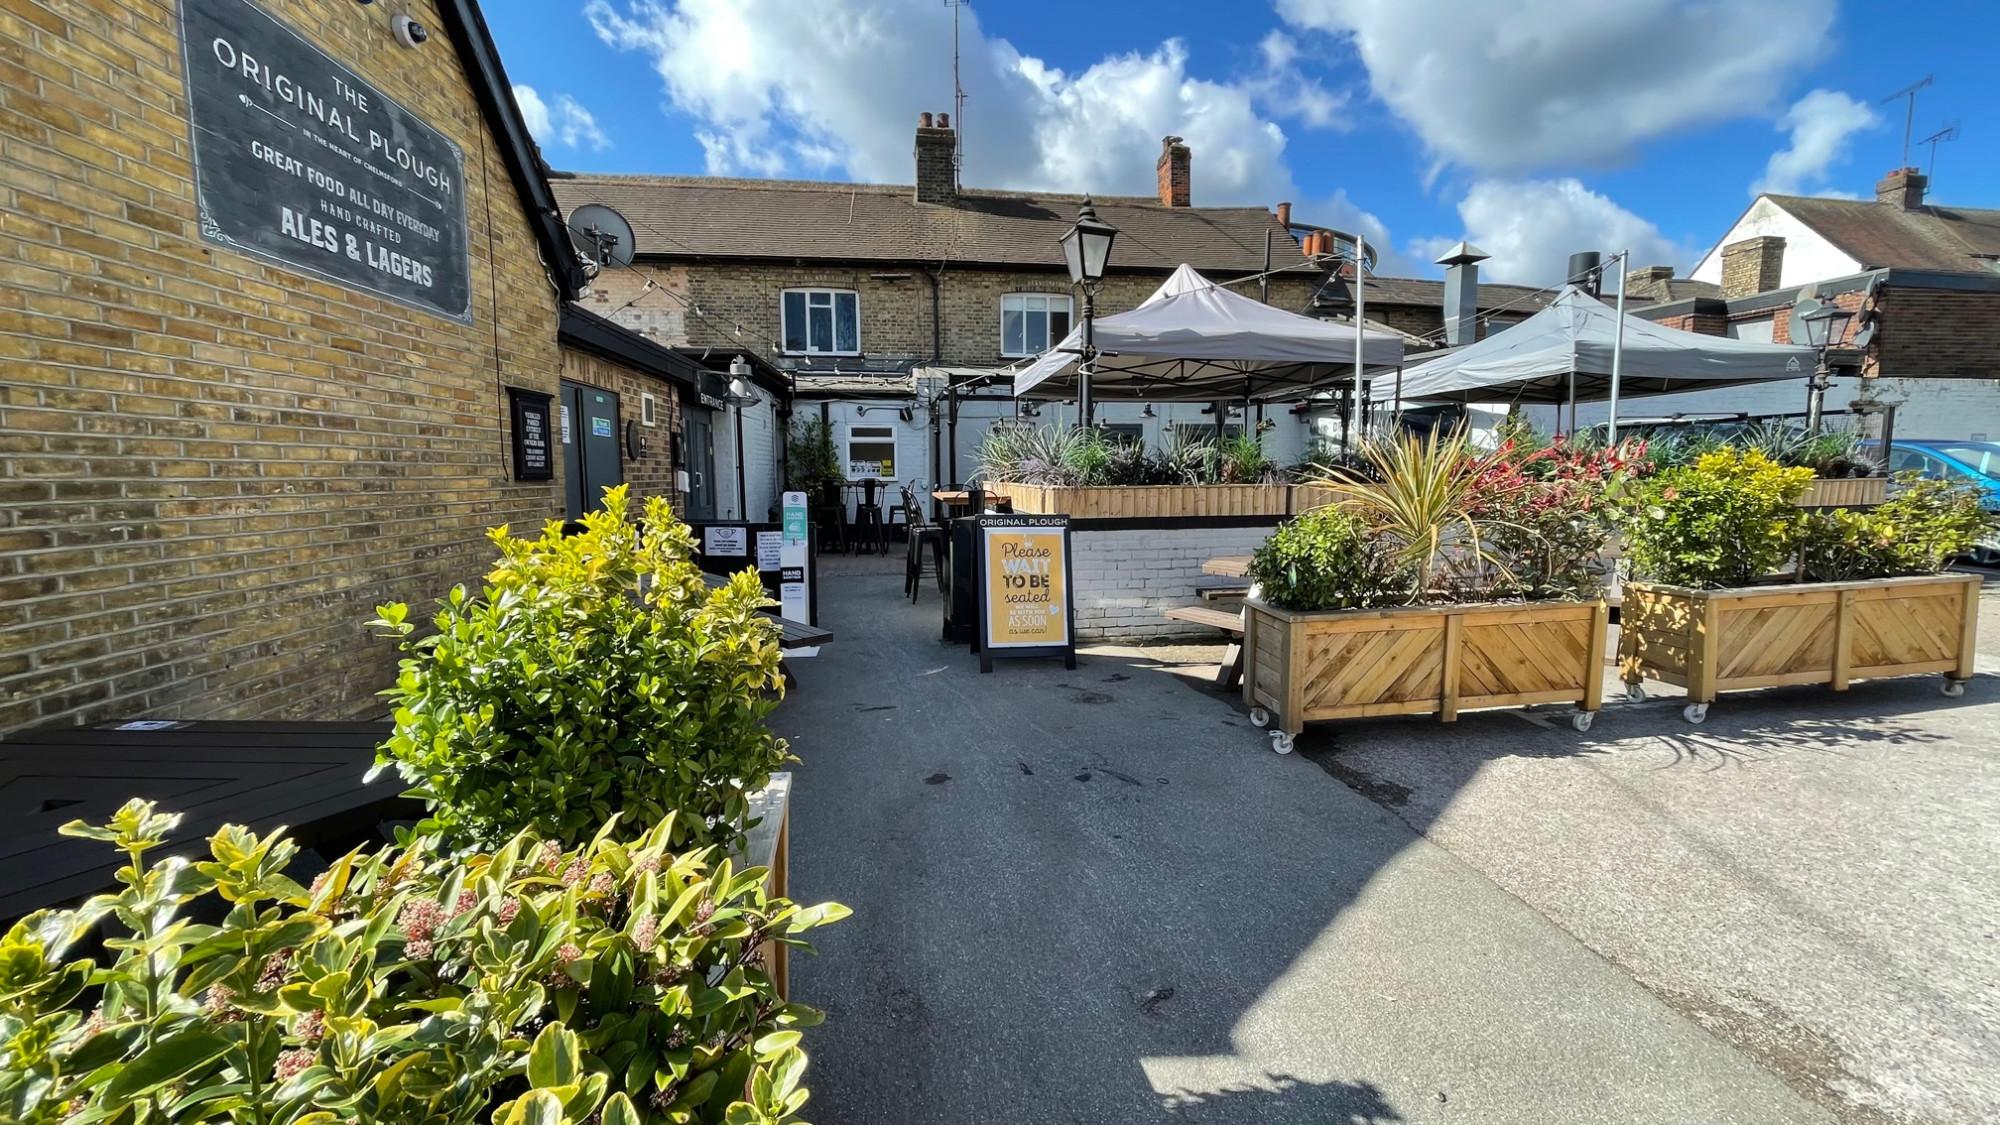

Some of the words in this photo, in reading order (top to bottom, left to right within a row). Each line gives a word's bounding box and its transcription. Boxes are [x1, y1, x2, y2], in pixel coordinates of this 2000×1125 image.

[332, 76, 369, 113] THE
[213, 38, 360, 143] ORIGINAL
[369, 129, 450, 194] PLOUGH
[303, 128, 312, 139] IN
[313, 134, 328, 147] THE
[329, 143, 352, 160] HEART
[353, 156, 362, 165] OF
[363, 162, 403, 187] CHELMSFORD
[252, 140, 303, 177] GREAT
[307, 166, 345, 197] FOOD
[349, 188, 371, 210] ALL
[372, 198, 394, 221] DAY
[396, 210, 440, 242] EVERYDAY
[320, 199, 351, 222] HAND
[355, 215, 401, 244] CRAFTED
[281, 206, 338, 254] ALES
[345, 233, 361, 262] &
[366, 241, 432, 287] LAGERS
[700, 392, 723, 410] ENTRANCE
[979, 518, 1025, 526] ORIGINAL
[1028, 518, 1068, 526] PLOUGH
[1001, 542, 1051, 558] Please
[1001, 559, 1051, 574] WAIT
[1002, 574, 1025, 588] TO
[1029, 574, 1050, 588] BE
[1004, 588, 1051, 603] seated
[1008, 615, 1020, 627] AS
[1022, 615, 1047, 627] SOON
